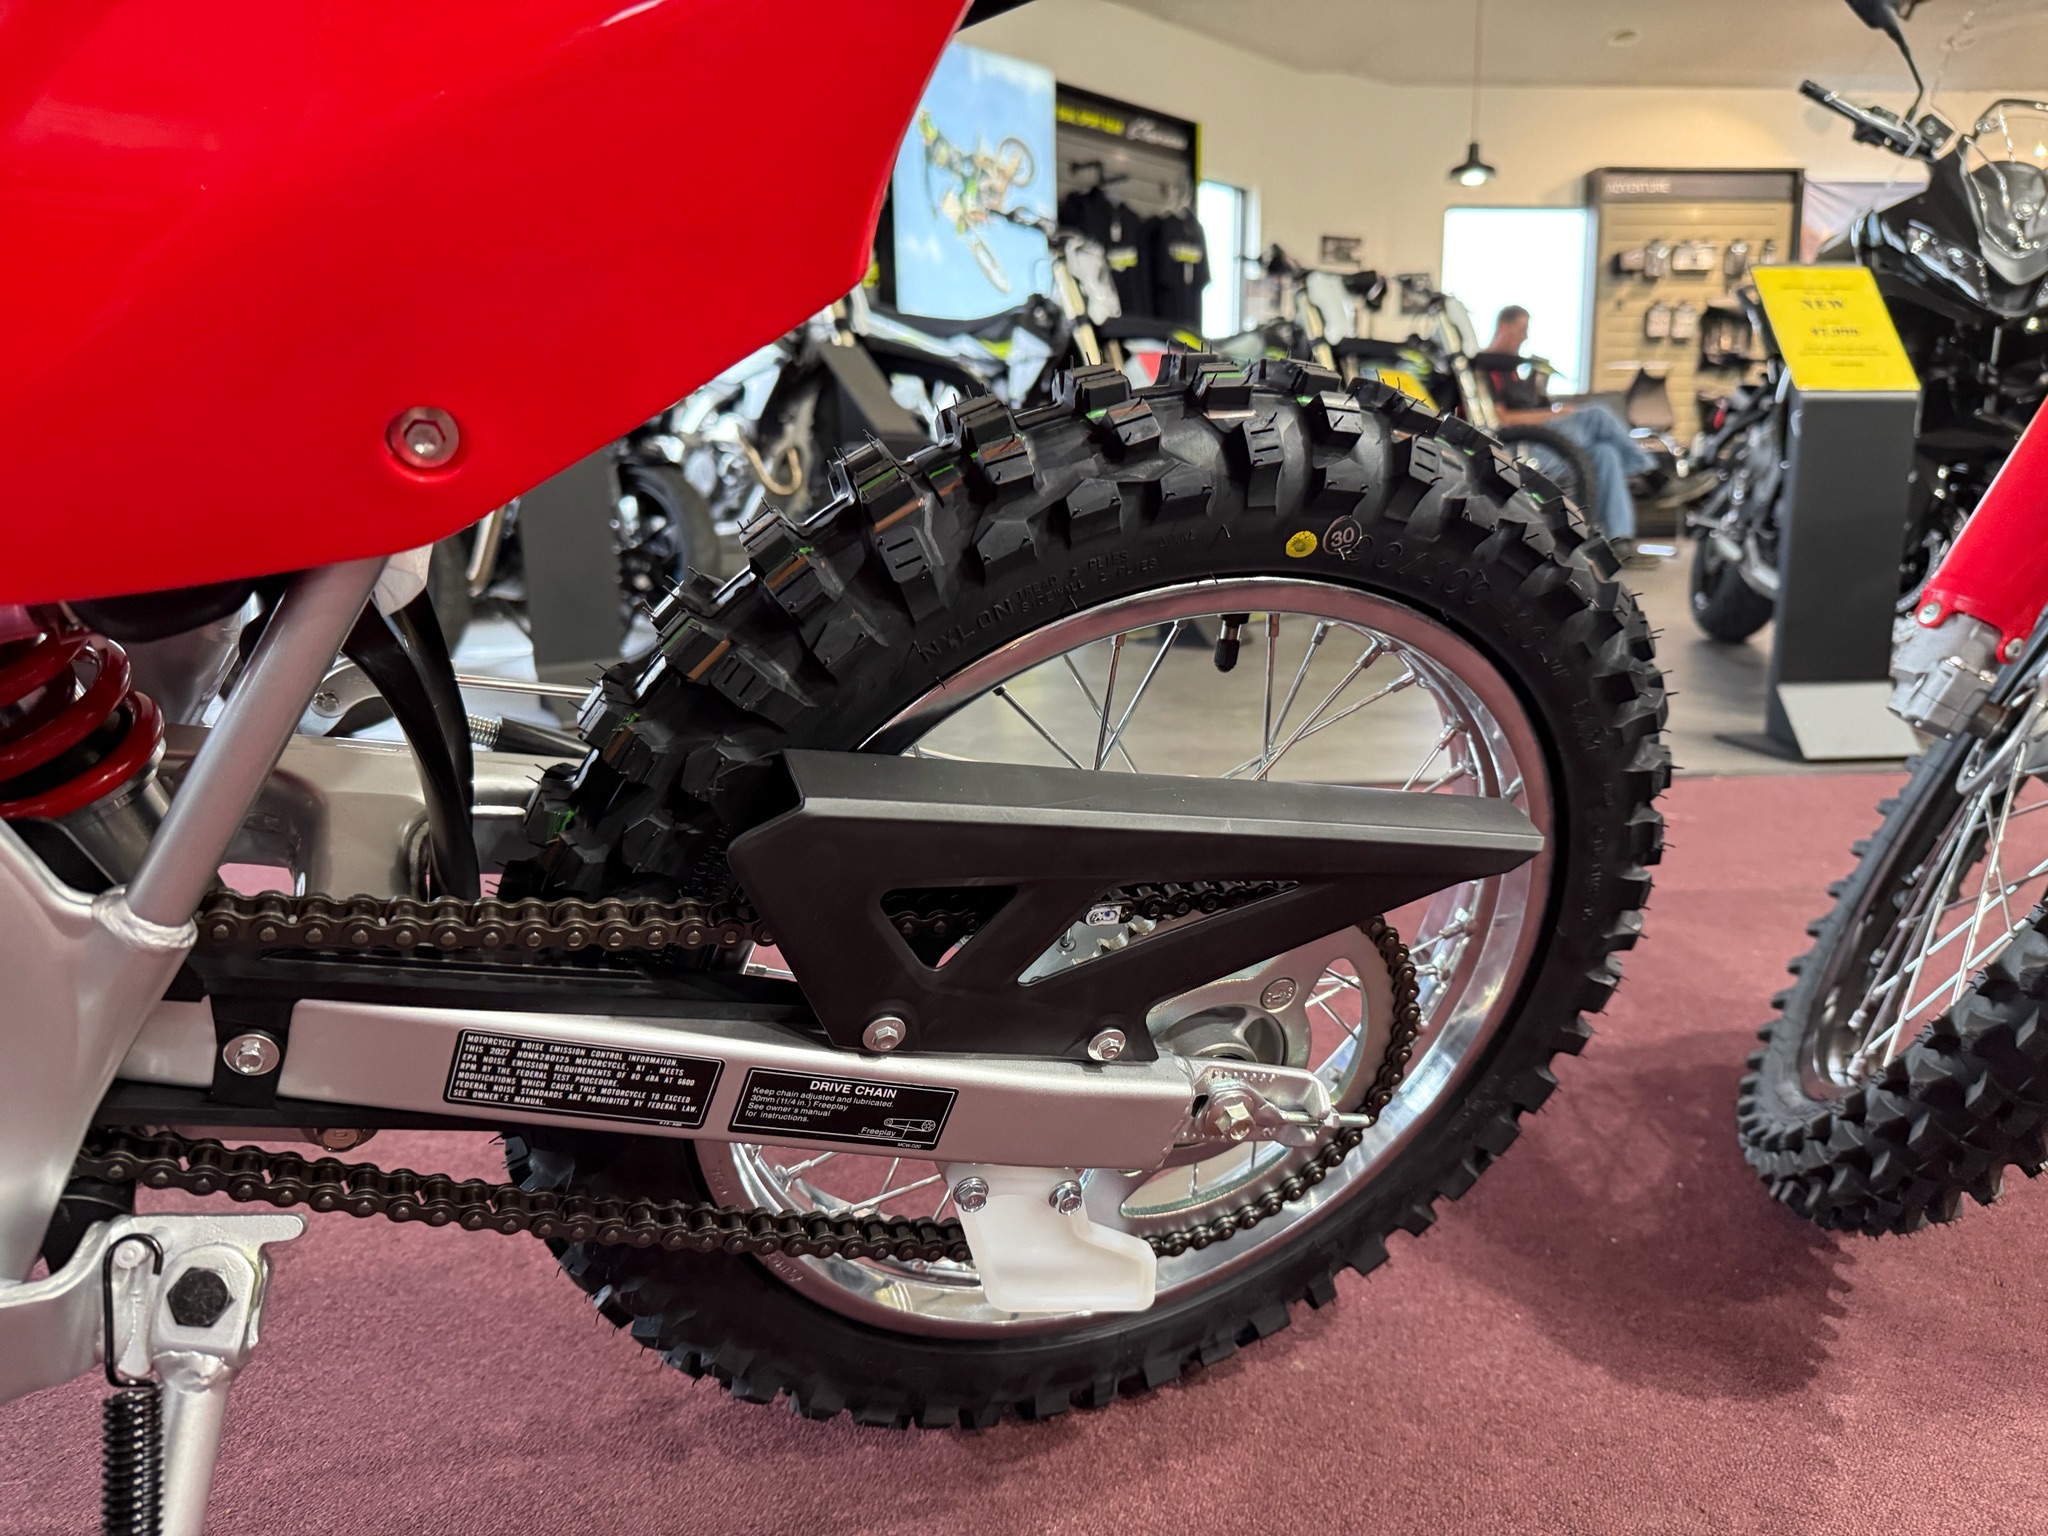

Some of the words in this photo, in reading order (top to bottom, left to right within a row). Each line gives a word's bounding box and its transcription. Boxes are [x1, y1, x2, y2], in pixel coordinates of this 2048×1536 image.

[1330, 526, 1354, 549] 30
[1015, 576, 1057, 599] TREAD
[1088, 549, 1128, 571] PLIES
[1021, 579, 1086, 613] SIDEWALL
[917, 598, 1015, 663] NYLON
[467, 1035, 516, 1047] MOTORCYCLE
[521, 1042, 545, 1050] NOISE
[549, 1046, 586, 1055] EMISSION
[591, 1050, 623, 1060] CONTROL
[462, 1053, 477, 1061] EPA
[483, 1056, 506, 1065] NOISE
[512, 1060, 549, 1069] EMISSION
[554, 1065, 611, 1077] REQUIREMENTS
[465, 1044, 484, 1053] THIS
[489, 1048, 510, 1056] 2027
[575, 1057, 630, 1071] MOTORCYCLE,
[659, 1067, 684, 1076] MEETS
[460, 1062, 477, 1071] RPM
[497, 1067, 511, 1075] THE
[516, 1069, 548, 1079] FEDERAL
[553, 1073, 570, 1081] TEST
[575, 1076, 620, 1087] PROCEDURE.
[453, 1089, 467, 1097] SEE
[473, 1091, 509, 1101] OWNER'S
[514, 1097, 546, 1106] MANUAL.
[456, 1081, 487, 1090] FEDERAL
[493, 1085, 515, 1093] NOISE
[521, 1088, 563, 1098] STANDARDS
[586, 1095, 630, 1105] PROHIBITED
[648, 1102, 677, 1110] FEDERAL
[458, 1072, 516, 1084] MODIFICATIONS
[521, 1079, 546, 1088] WHICH
[551, 1082, 575, 1091] CAUSE
[579, 1084, 596, 1094] THIS
[600, 1088, 647, 1098] MOTORCYCLE
[664, 1095, 691, 1103] EXCEED
[753, 1087, 775, 1096] Keep
[776, 1089, 799, 1098] chain
[800, 1092, 835, 1102] adjusted
[853, 1097, 894, 1108] lubricated.
[810, 1080, 852, 1094] DRIVE
[857, 1086, 897, 1099] CHAIN
[748, 1102, 764, 1111] See
[766, 1105, 799, 1114] owner's
[800, 1108, 831, 1117] manual
[751, 1095, 775, 1104] 30mm
[813, 1101, 849, 1111] Freeplay
[760, 1112, 809, 1123] instructions.
[861, 1127, 896, 1137] Freeplay
